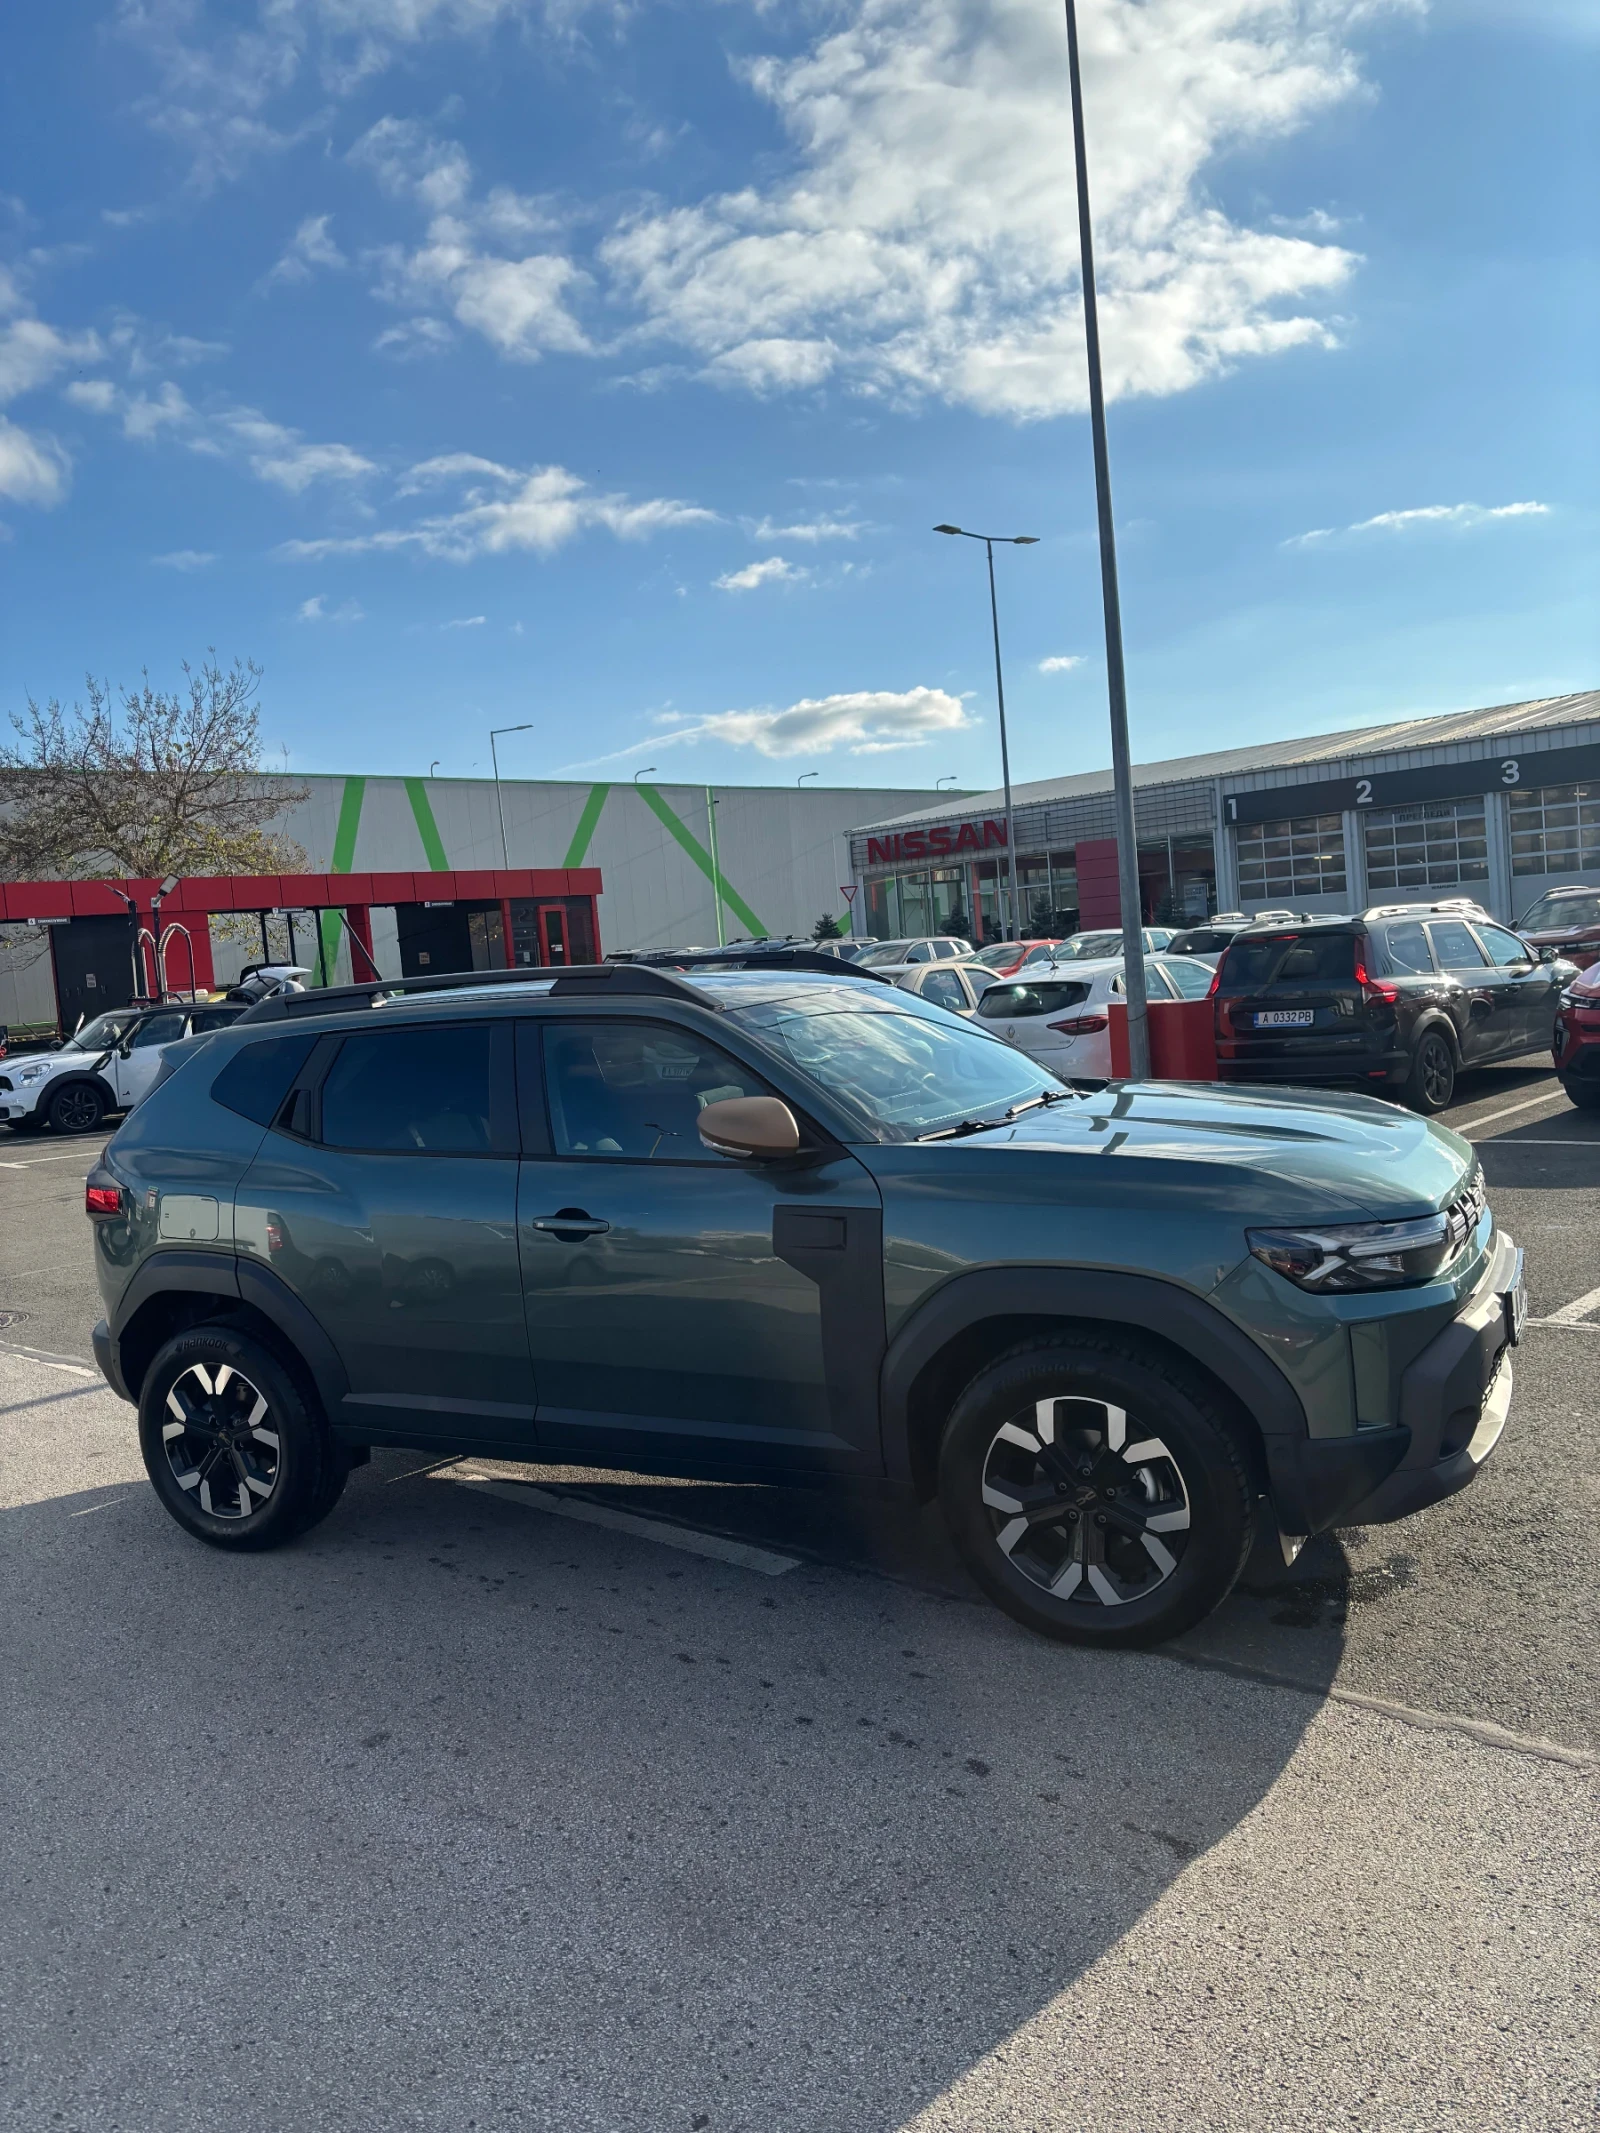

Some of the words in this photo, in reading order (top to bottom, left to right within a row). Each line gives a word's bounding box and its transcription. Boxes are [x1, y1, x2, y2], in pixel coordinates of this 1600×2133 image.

[1501, 760, 1520, 784] 3
[1356, 780, 1373, 804] 2
[1227, 798, 1237, 820] 1
[867, 818, 1008, 864] NISSAN
[1262, 1012, 1269, 1024] A
